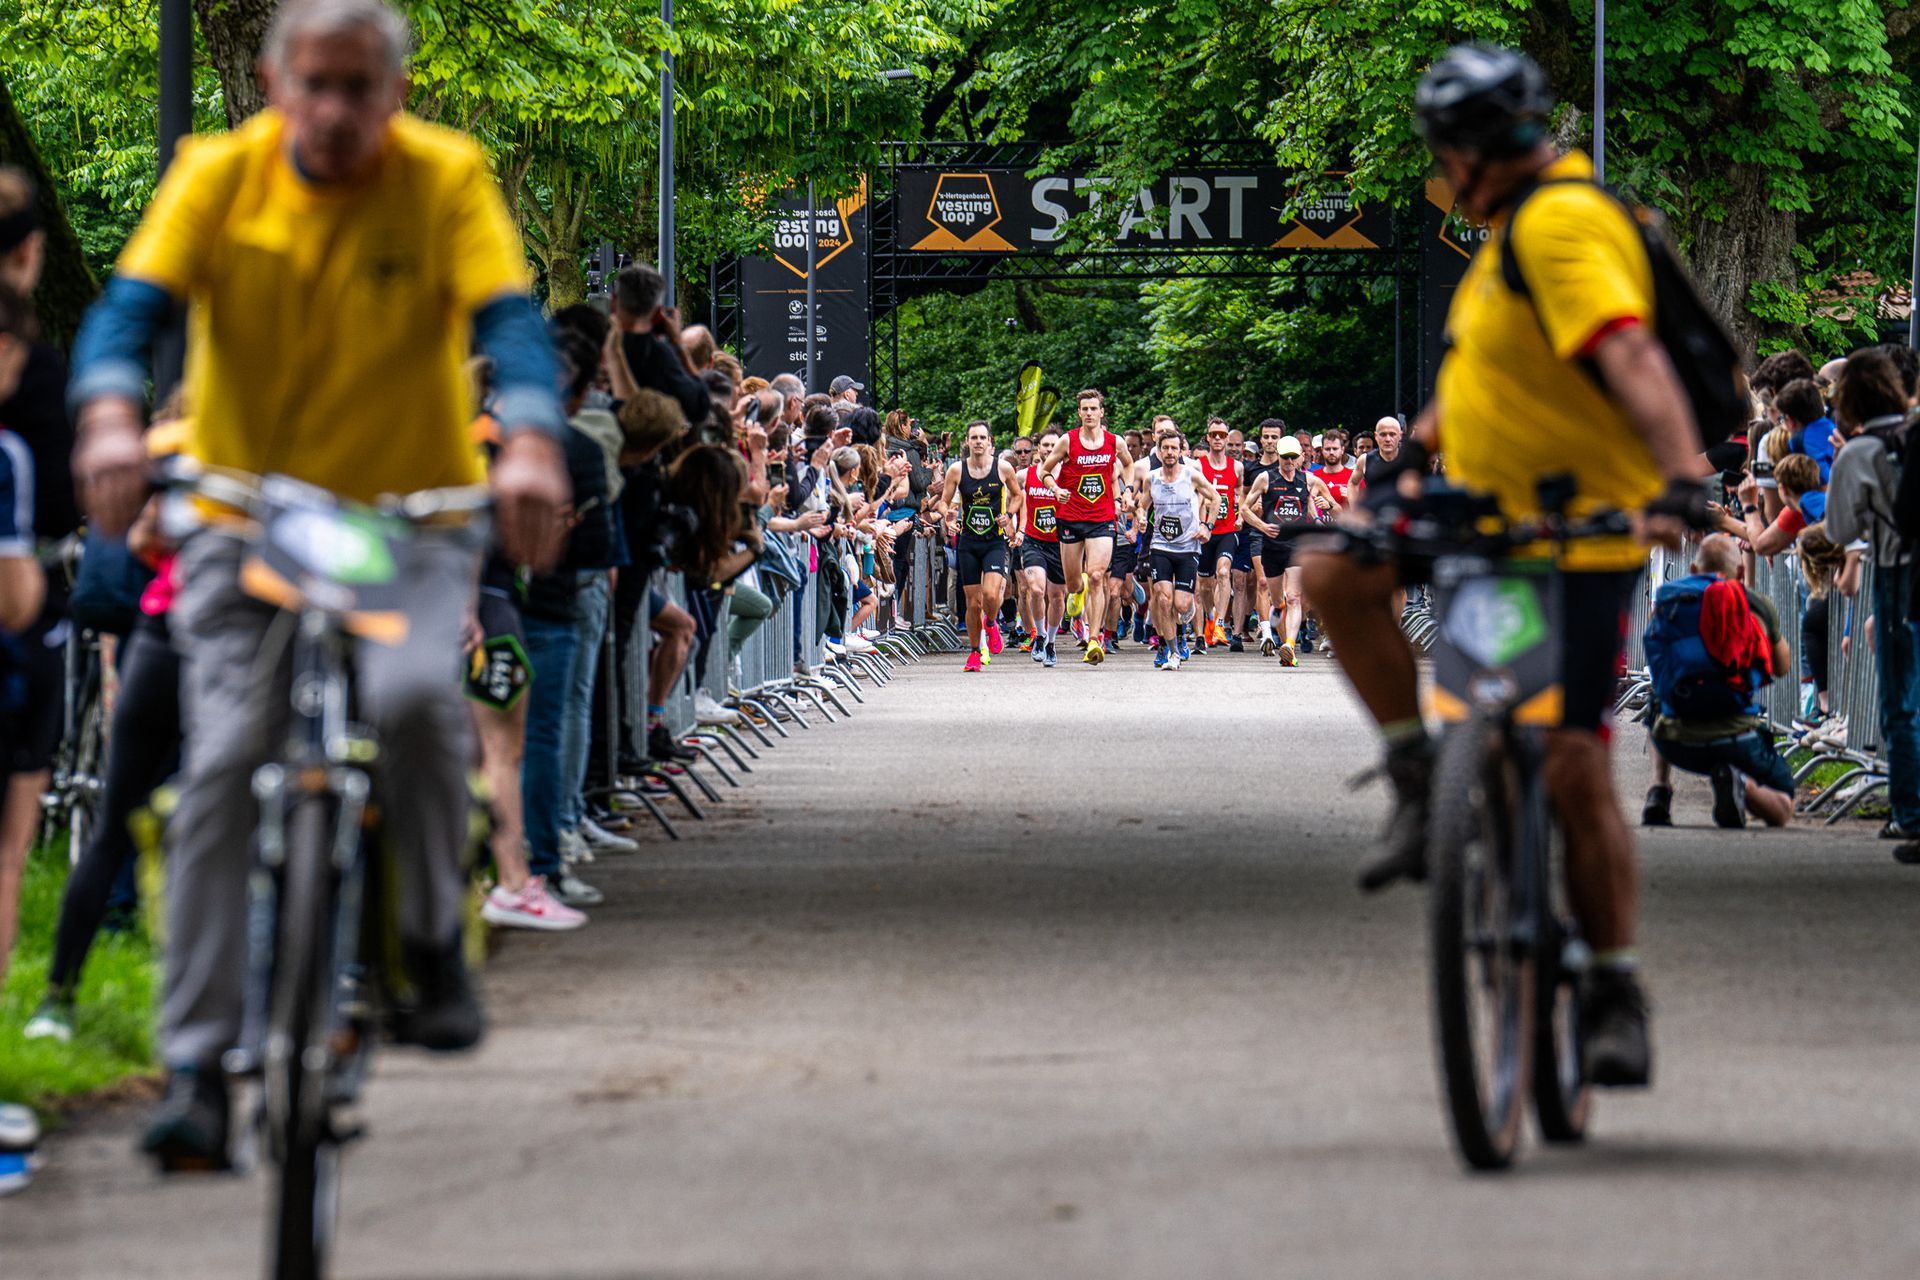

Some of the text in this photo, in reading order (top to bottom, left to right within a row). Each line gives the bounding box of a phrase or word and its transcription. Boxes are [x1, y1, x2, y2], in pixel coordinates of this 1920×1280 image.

[936, 201, 992, 214] vesting
[1299, 198, 1353, 212] sting
[942, 211, 975, 225] loop
[1302, 210, 1335, 223] loop
[773, 219, 839, 237] estng
[774, 233, 818, 251] loo
[818, 239, 840, 247] 2024
[789, 351, 822, 361] sticd
[1083, 485, 1101, 493] 7785
[1280, 508, 1298, 516] 2246
[970, 516, 990, 527] 3430
[1161, 525, 1178, 535] 6361
